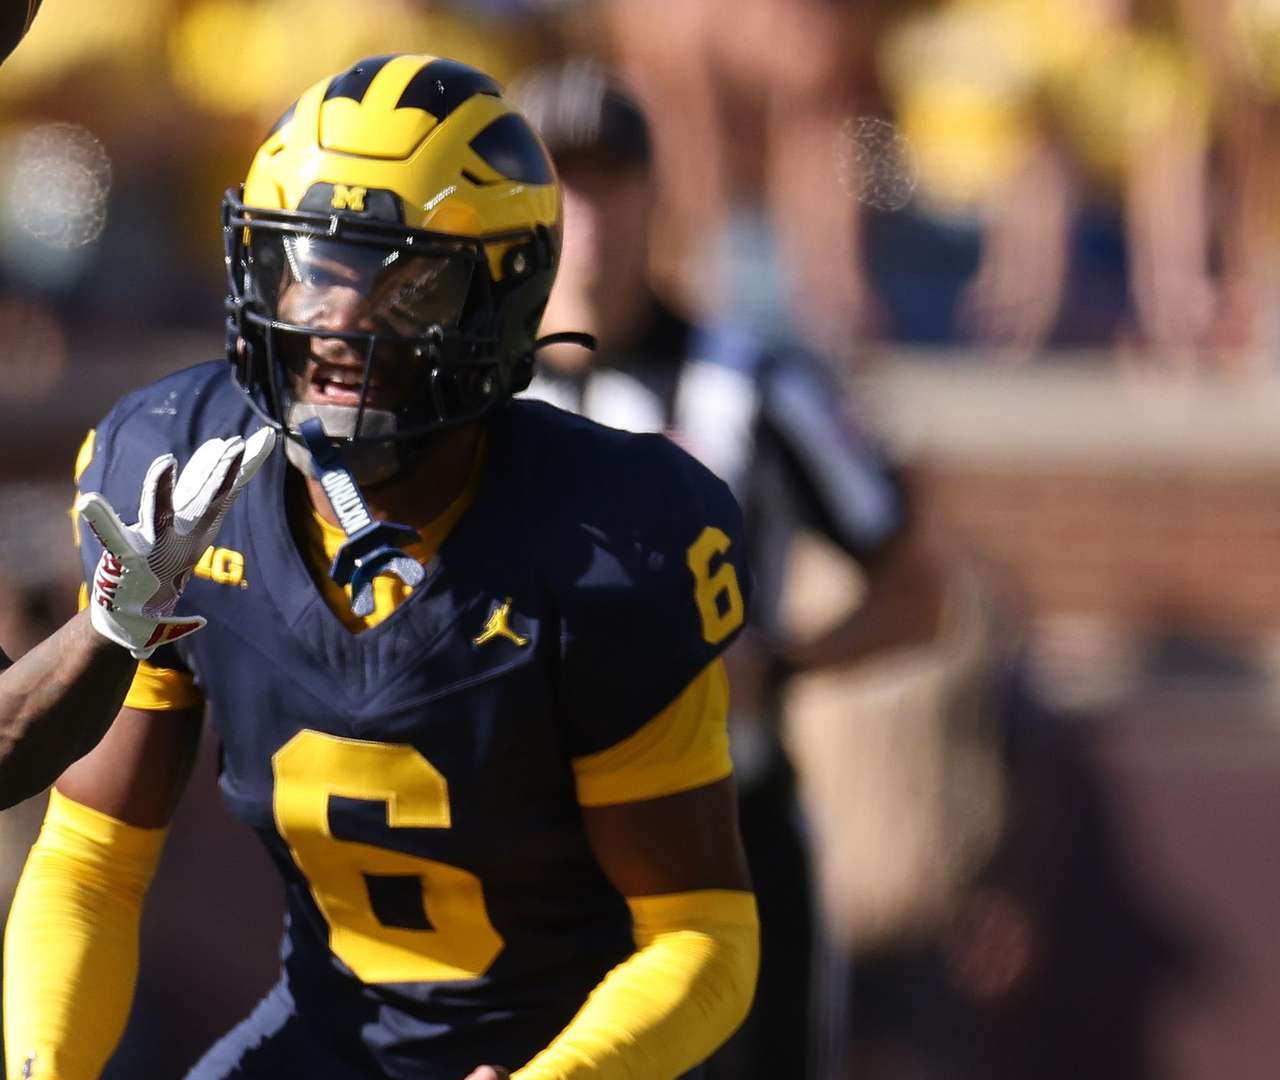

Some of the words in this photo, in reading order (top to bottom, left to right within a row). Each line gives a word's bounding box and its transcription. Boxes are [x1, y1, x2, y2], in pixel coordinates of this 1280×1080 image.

[331, 185, 367, 211] M
[686, 526, 744, 645] 6
[272, 728, 505, 985] 6
